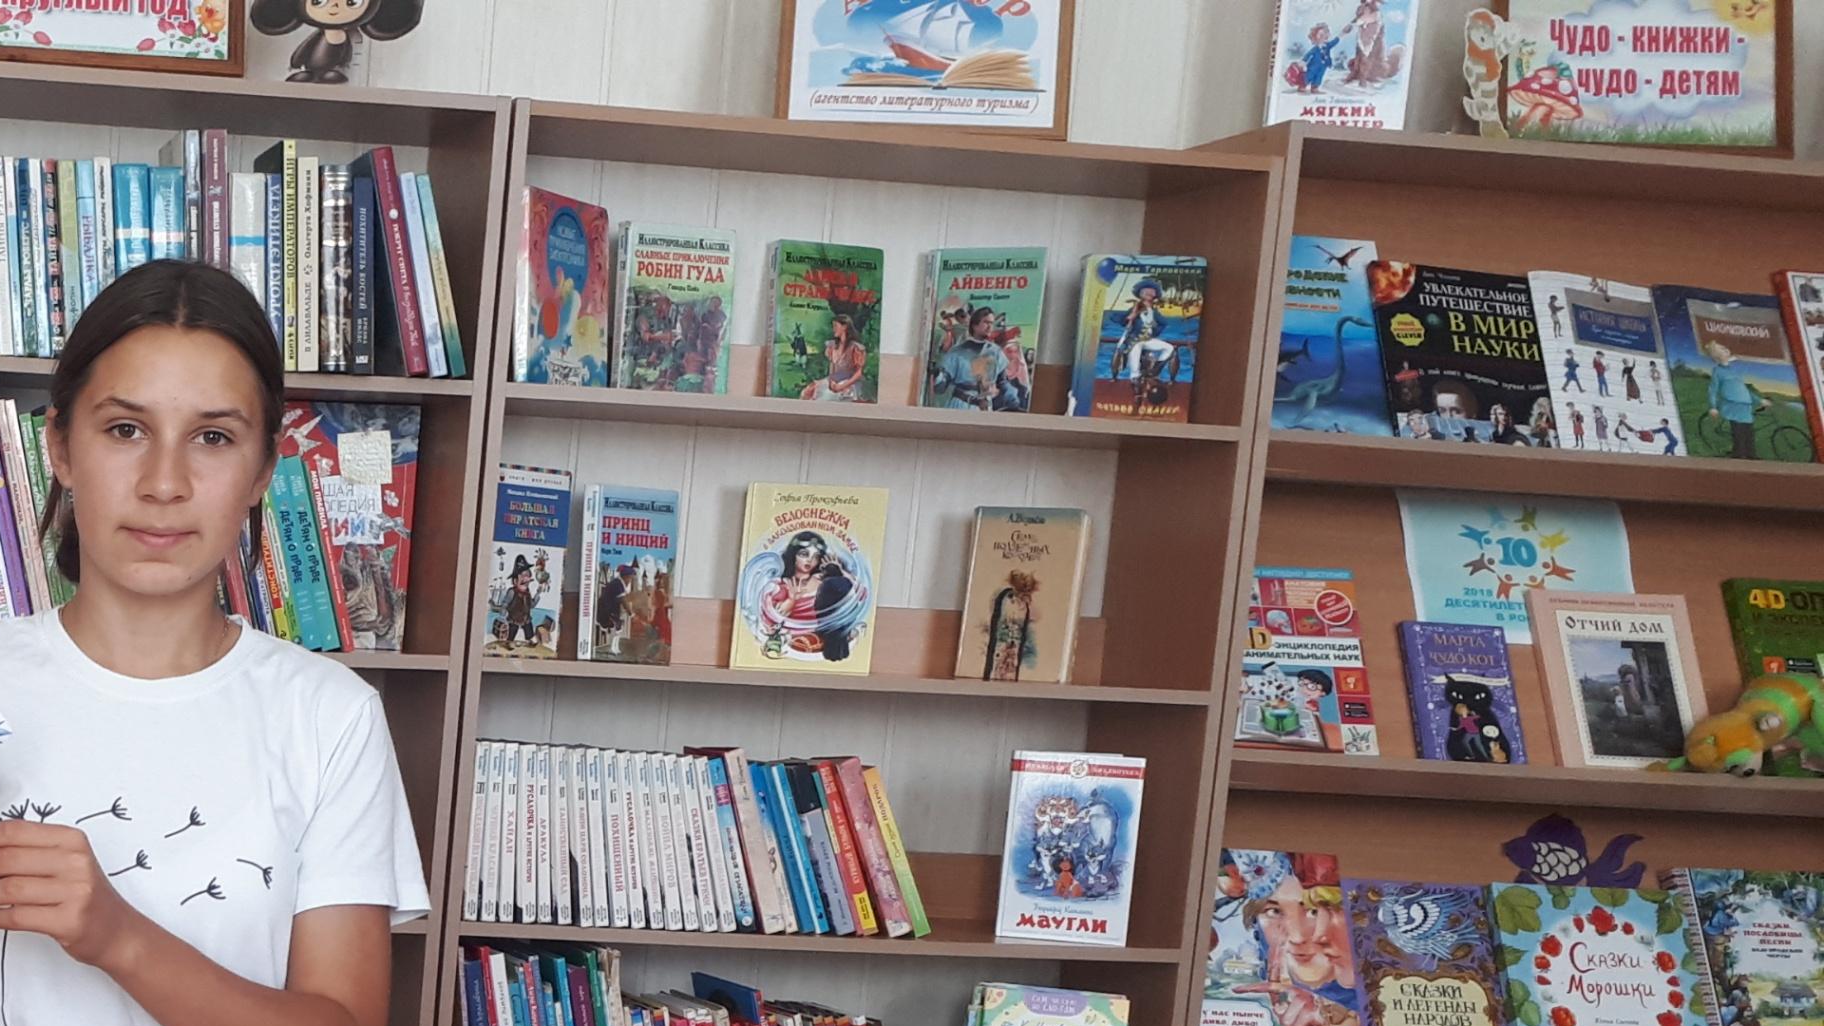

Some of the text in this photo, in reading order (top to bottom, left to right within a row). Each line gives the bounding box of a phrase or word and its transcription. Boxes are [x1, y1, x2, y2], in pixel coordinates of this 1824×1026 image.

[1549, 18, 1610, 54] Чудо
[1632, 22, 1729, 54] книжки
[1577, 66, 1637, 98] чудо
[1658, 68, 1741, 101] детям
[809, 89, 1030, 113] (агентство литературного туризма
[285, 157, 295, 278] ИГРЫ ИМПЕРАТОРОВ
[81, 214, 96, 283] РЫБАЛКА
[357, 207, 369, 310] ПОХИТИТЕЛЬ КОСТЕЙ
[636, 261, 725, 283] РОБИН ГУДА
[949, 274, 1029, 291] АЙВЕНГО
[1423, 281, 1530, 305] УВЛЕКАТЕЛЬНОЕ
[1419, 293, 1533, 319] ПУТЕШЕСТВИЕ
[1448, 311, 1536, 340] В МИР
[1704, 320, 1771, 339] ЦИОЛКОВСКИЙ
[1452, 334, 1541, 362] НАУКИ
[509, 500, 556, 515] БОЛЬШАЯ
[774, 507, 851, 530] БЕЛОСНЕЖКА
[503, 513, 559, 529] ПИРАТСКАЯ
[602, 515, 651, 532] ПРИНЦ
[280, 508, 303, 584] ДЕТЯМ О ПРАВЕ
[297, 508, 321, 584] ДЕТЯМ О ПРАВЕ
[515, 528, 545, 541] КНИГА
[601, 531, 669, 548] И НИЩИЙ
[1496, 536, 1538, 568] 10
[1445, 598, 1529, 611] ДЕСЯТИЛЕТ
[1434, 634, 1486, 648] МАРТА
[1333, 652, 1361, 663] НАУК
[505, 811, 515, 853] ХАЙДИ
[539, 818, 548, 864] ДРАКУЛА
[610, 813, 624, 892] ПОХИЩЕННЫЙ
[1568, 942, 1643, 974] Сказки
[1400, 983, 1463, 998] СКАЗКИ
[1566, 974, 1656, 1008] Морошки
[1393, 998, 1477, 1014] И ЛЕГЕНДЫ
[1404, 1012, 1473, 1026] НАРОДОВ
